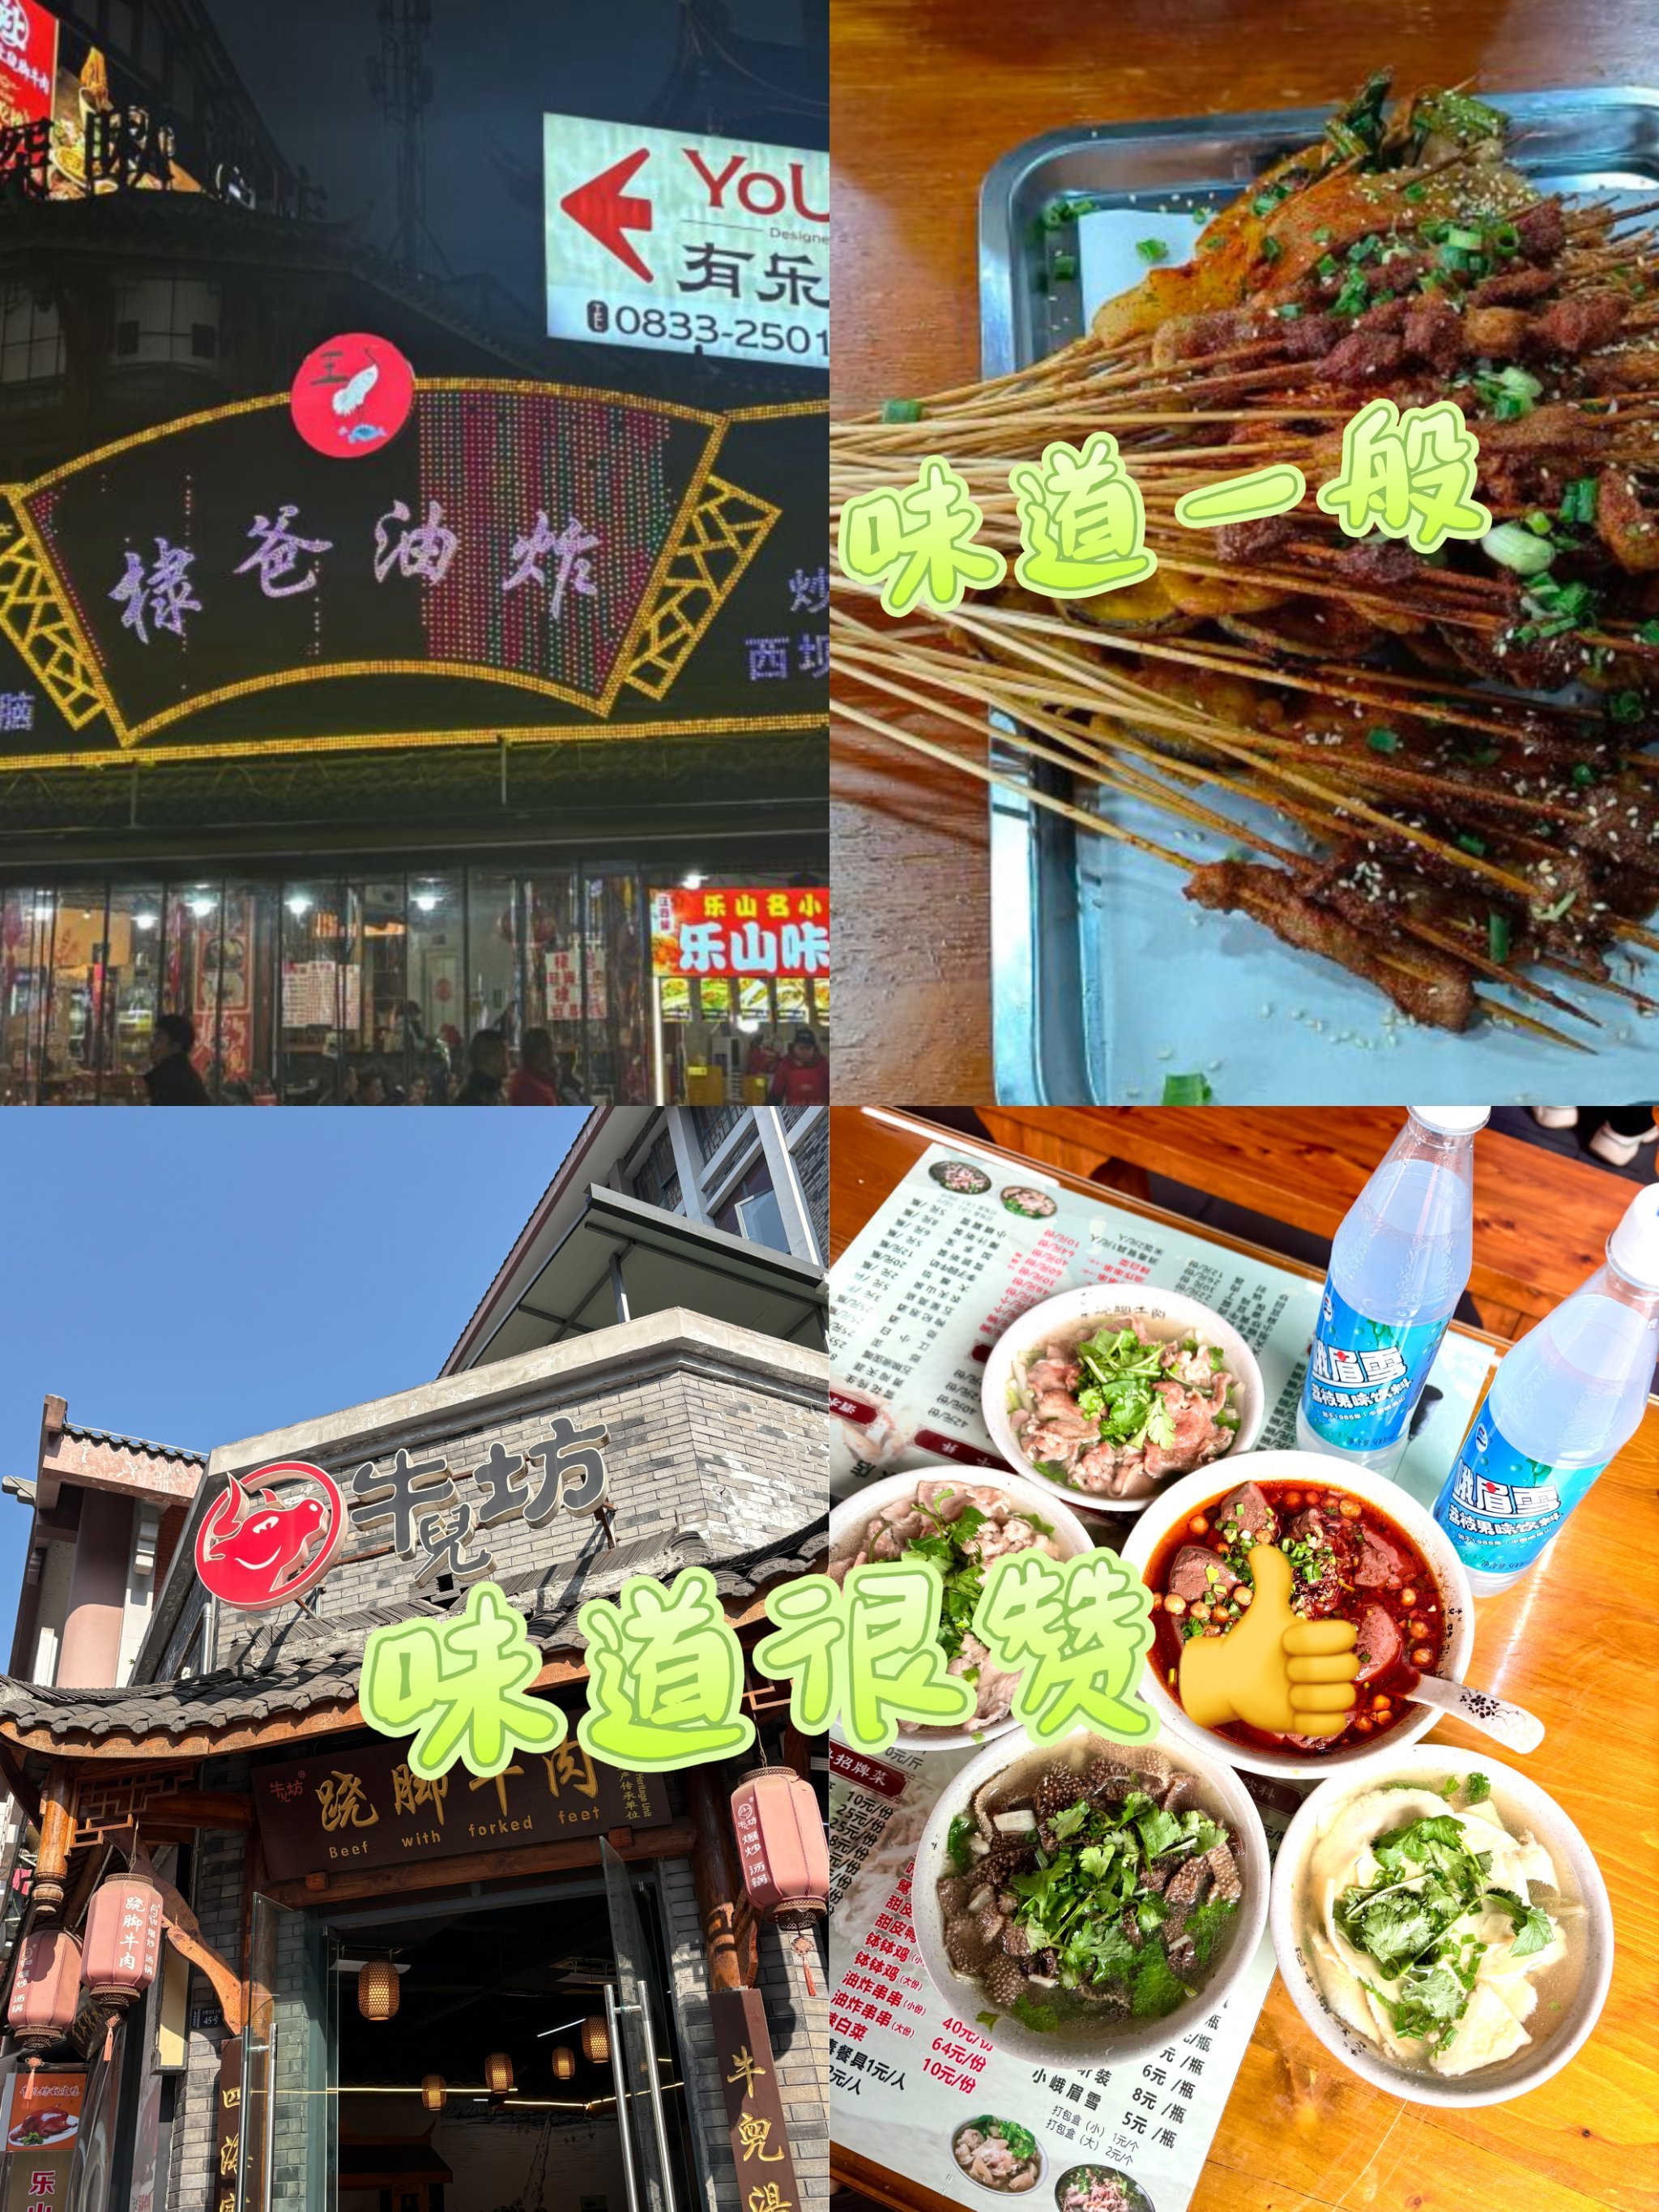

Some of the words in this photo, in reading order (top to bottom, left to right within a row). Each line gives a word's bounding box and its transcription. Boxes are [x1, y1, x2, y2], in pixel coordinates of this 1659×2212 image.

[704, 894, 821, 918] 乐山名小
[830, 1318, 856, 1338] 25元/
[1311, 1378, 1413, 1409] 荔枝果味饮料
[1448, 1502, 1563, 1536] 荔枝果味饮料
[885, 1747, 923, 1774] 0元/斤
[616, 1768, 641, 1820] 产传承单位
[847, 1791, 894, 1820] 10元/份
[329, 1840, 369, 1859] Beef
[402, 1830, 441, 1848] with
[468, 1816, 534, 1838] forked
[558, 1806, 600, 1824] feet
[835, 1804, 885, 1836] 25元/份
[828, 1834, 868, 1860] 8元/份
[829, 1851, 860, 1875] 元/份
[119, 1896, 146, 1971] 跷脚牛肉
[875, 1913, 915, 1942] 甜皮鸭
[932, 2037, 986, 2072] 64元/份
[1159, 2047, 1204, 2075] 元/瓶
[923, 2058, 975, 2093] 10元/份
[1032, 2069, 1100, 2110] 小峨眉雪
[1105, 2146, 1132, 2166] 2元/个
[1112, 2133, 1138, 2151] 1元/个
